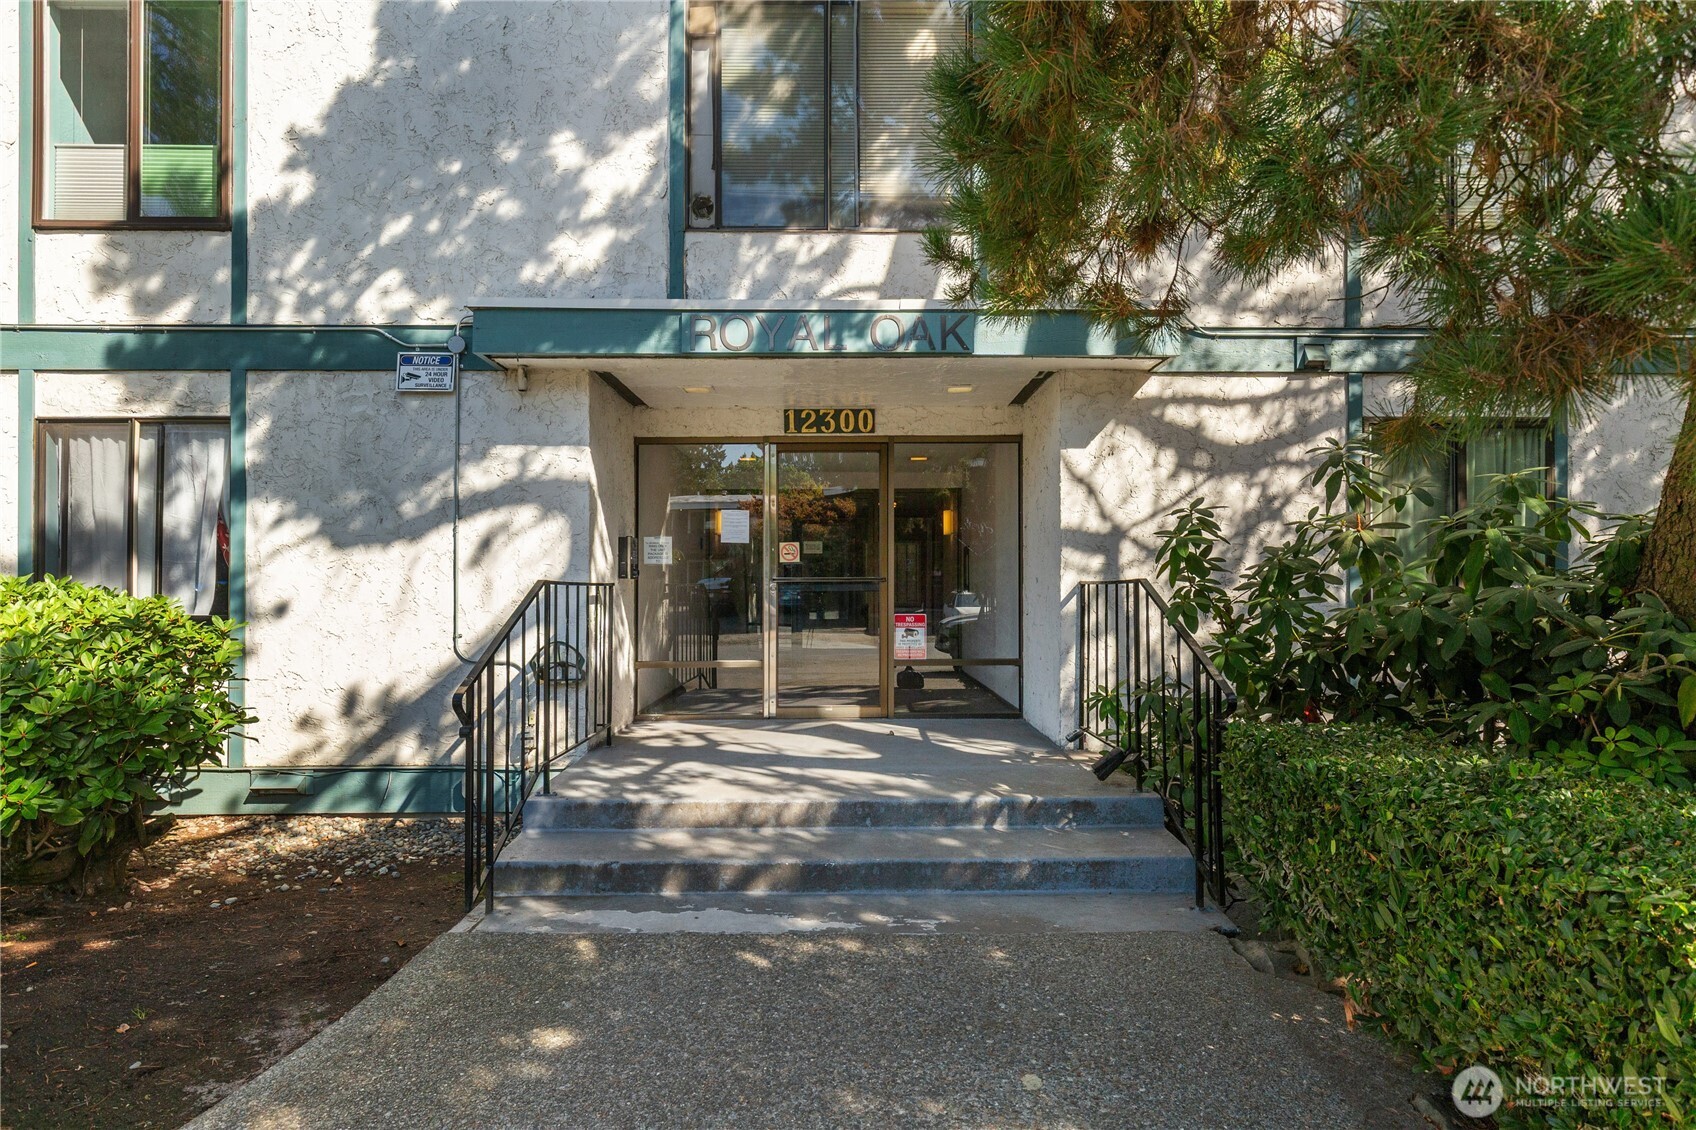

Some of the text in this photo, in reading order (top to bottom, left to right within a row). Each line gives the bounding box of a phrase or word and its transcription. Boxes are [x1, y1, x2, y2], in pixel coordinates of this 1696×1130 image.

[690, 314, 970, 351] ROYAL OAK
[412, 356, 441, 365] NOTICE
[785, 409, 873, 433] 12300
